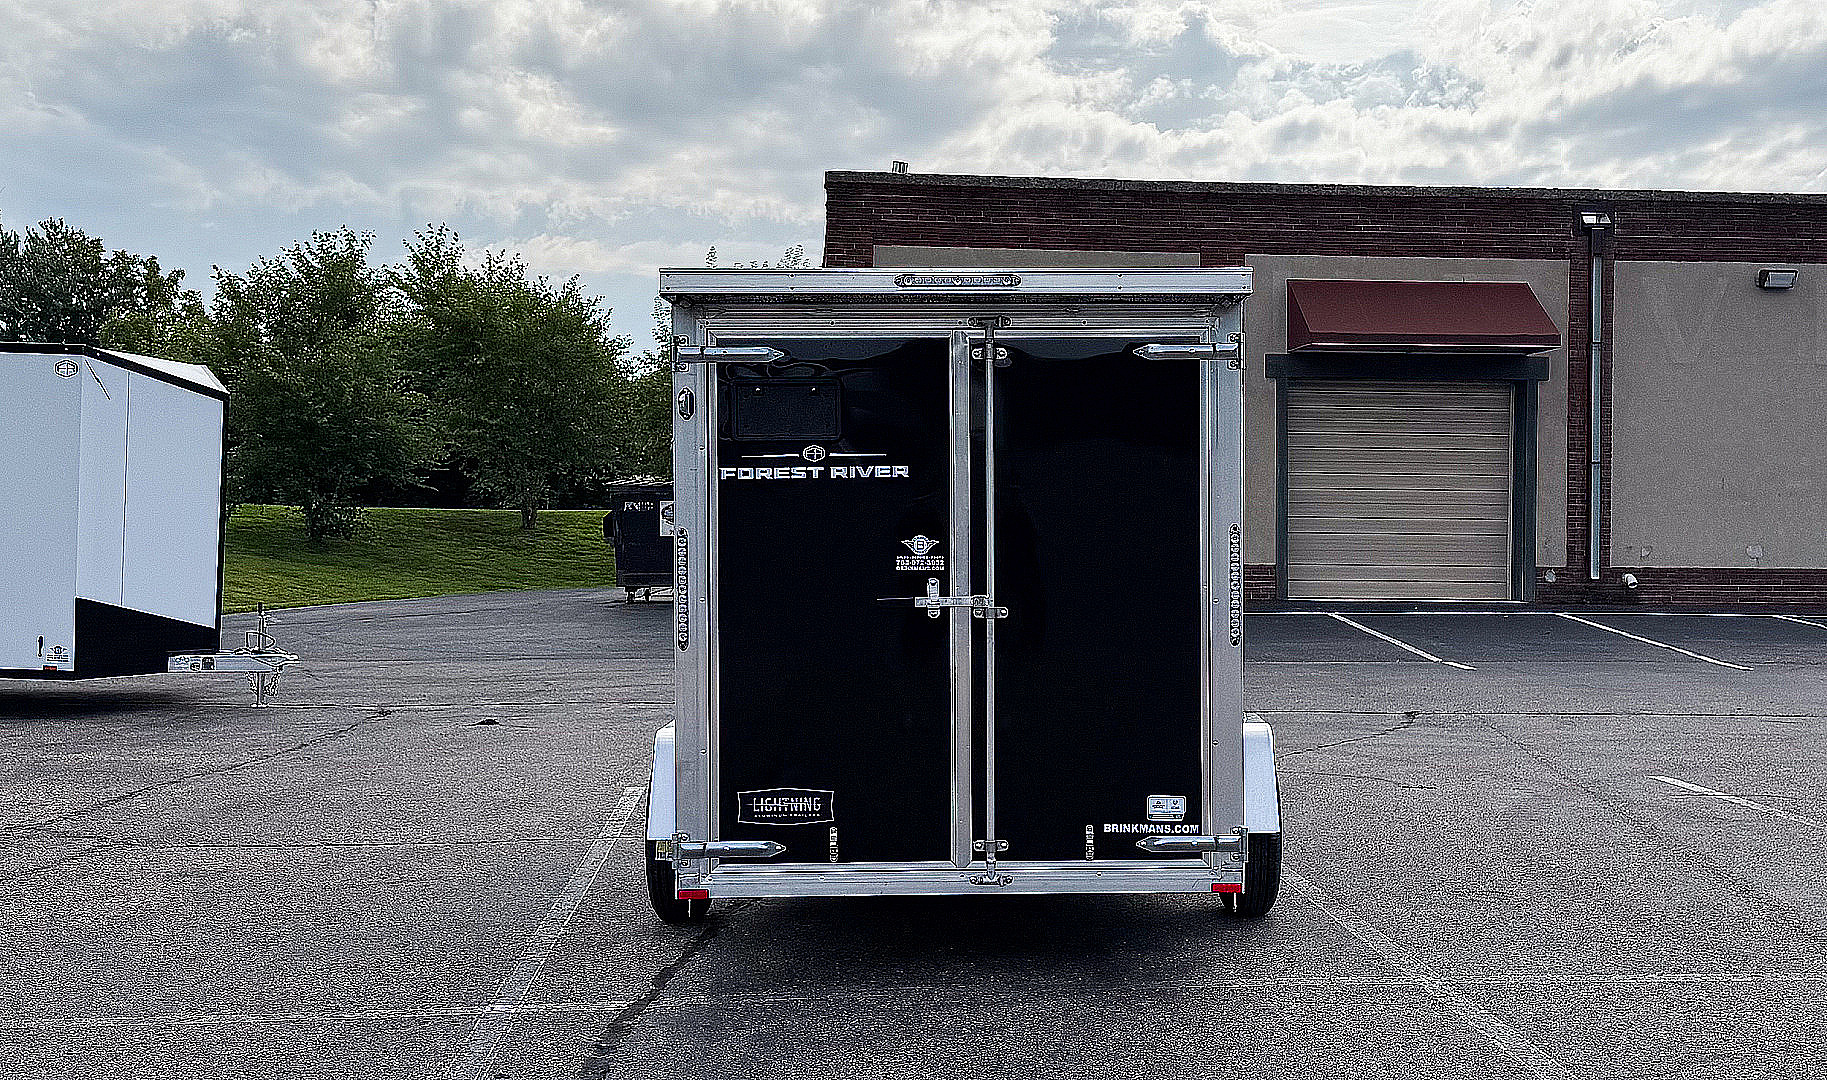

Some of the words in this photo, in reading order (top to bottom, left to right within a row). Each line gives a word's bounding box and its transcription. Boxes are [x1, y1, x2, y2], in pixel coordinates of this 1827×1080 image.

[719, 466, 825, 480] FOREST
[830, 465, 910, 479] RIVER
[753, 797, 821, 812] LIGHTNING
[1103, 823, 1200, 834] BRINKMANS.COM
